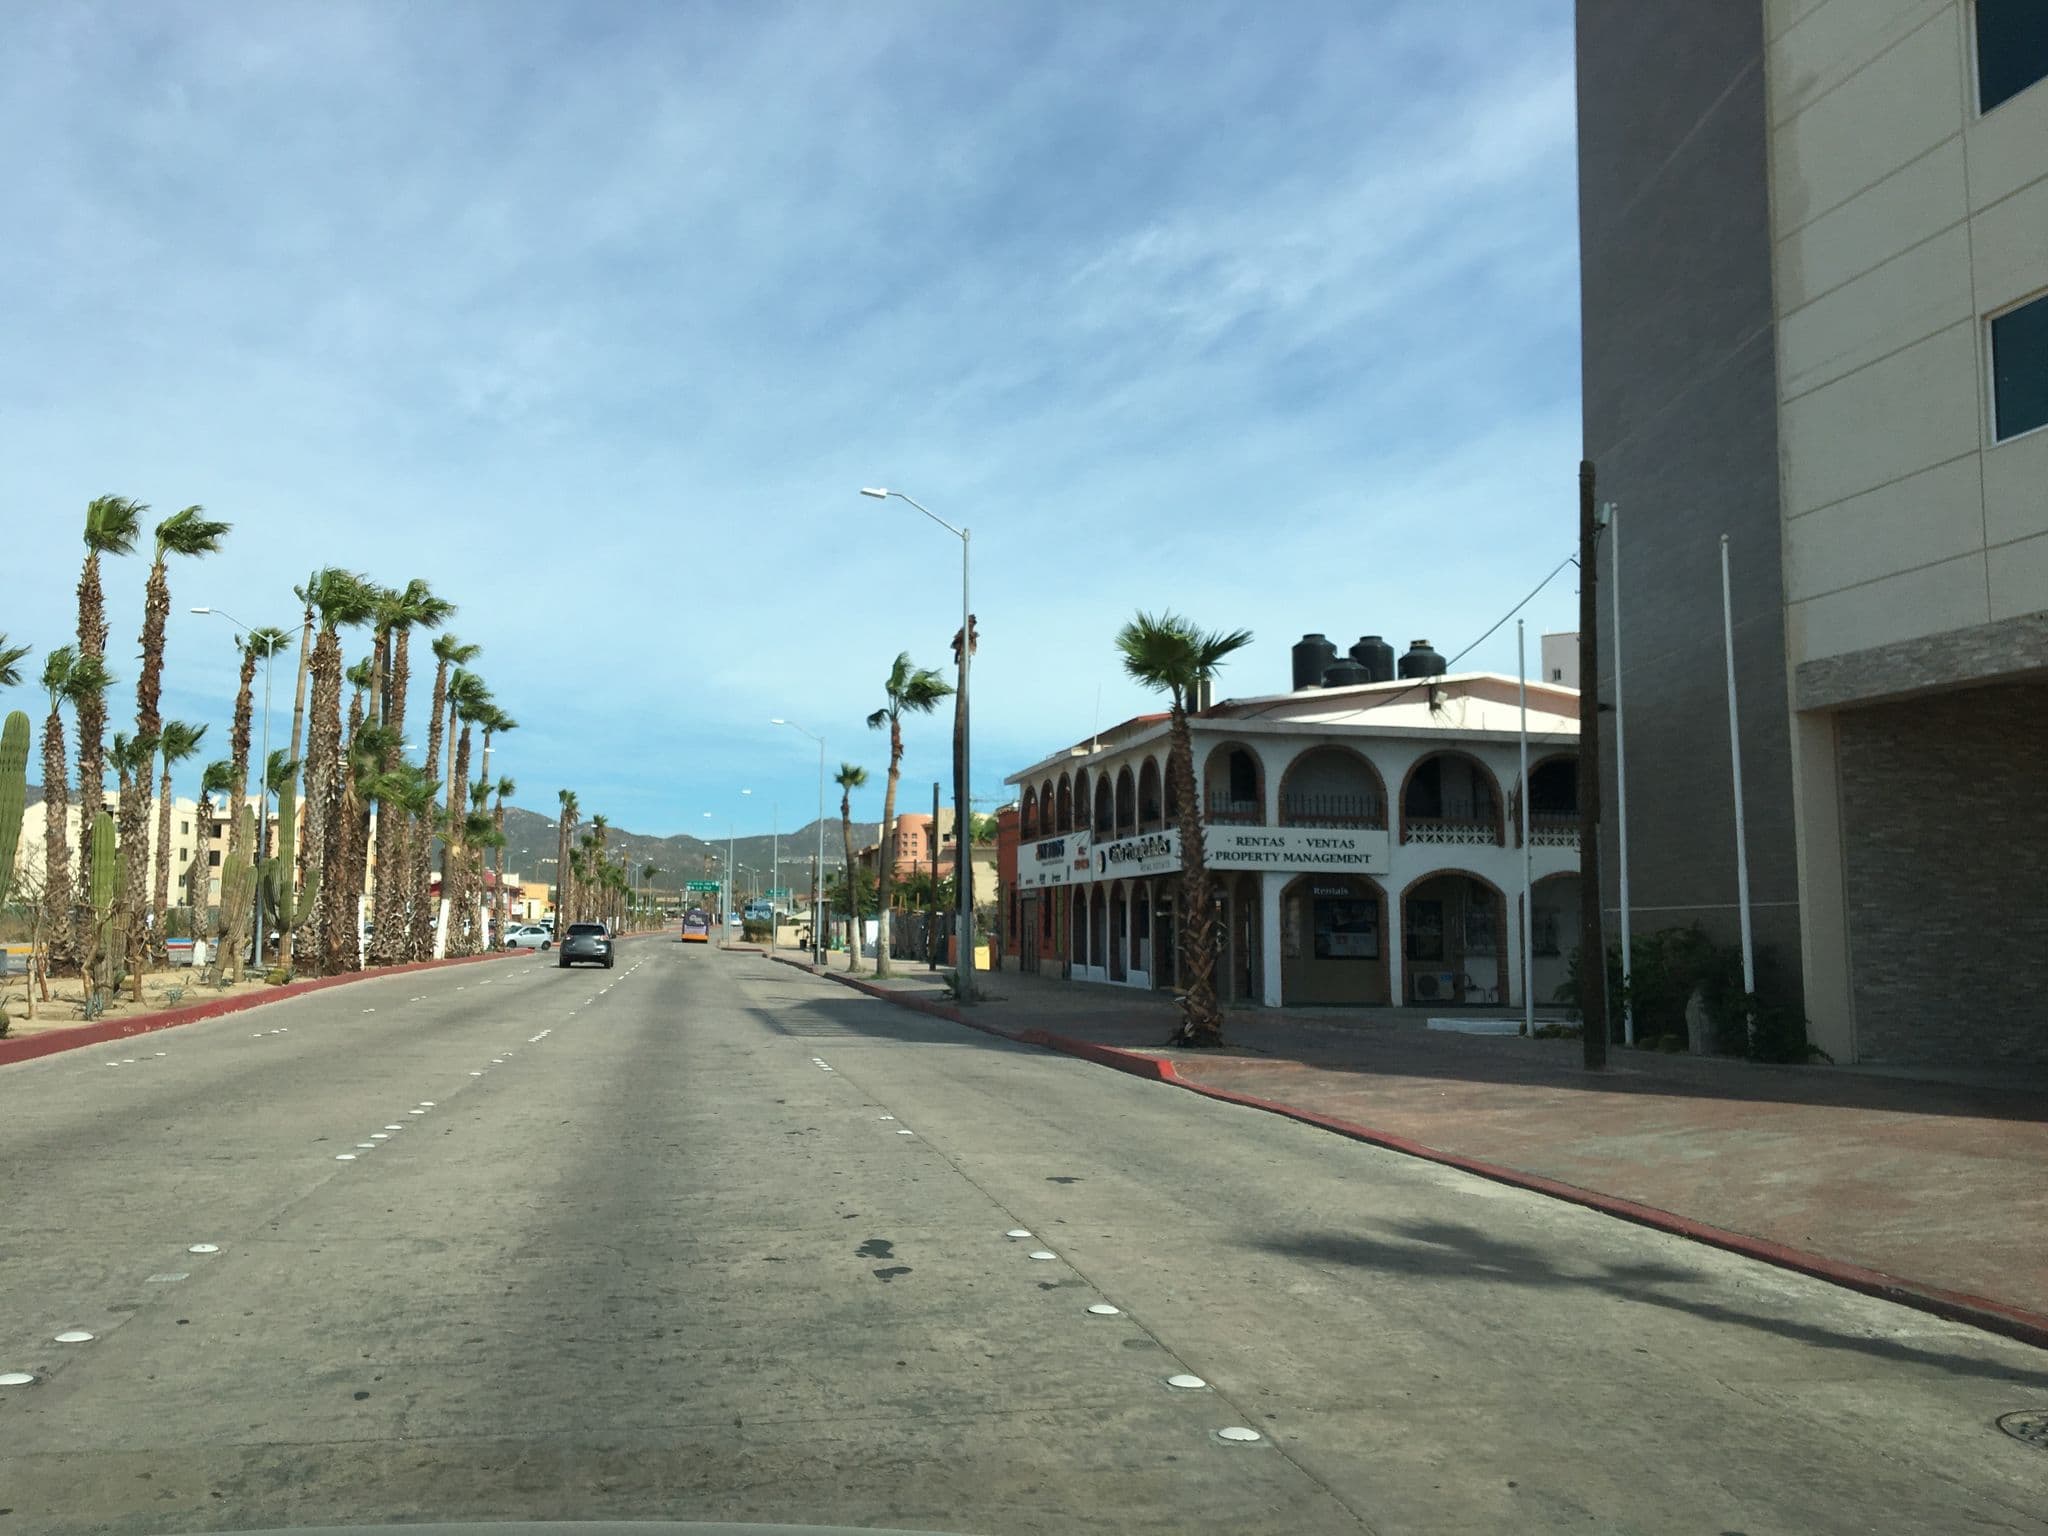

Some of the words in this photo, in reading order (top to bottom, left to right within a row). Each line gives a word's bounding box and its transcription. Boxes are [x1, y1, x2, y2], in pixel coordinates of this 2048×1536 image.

[1236, 836, 1285, 847] RENTAS
[1306, 838, 1355, 849] VENTAS
[1215, 851, 1280, 862] PROPERTY
[1283, 853, 1372, 864] MANAGEMENT
[1313, 887, 1349, 896] Rentals
